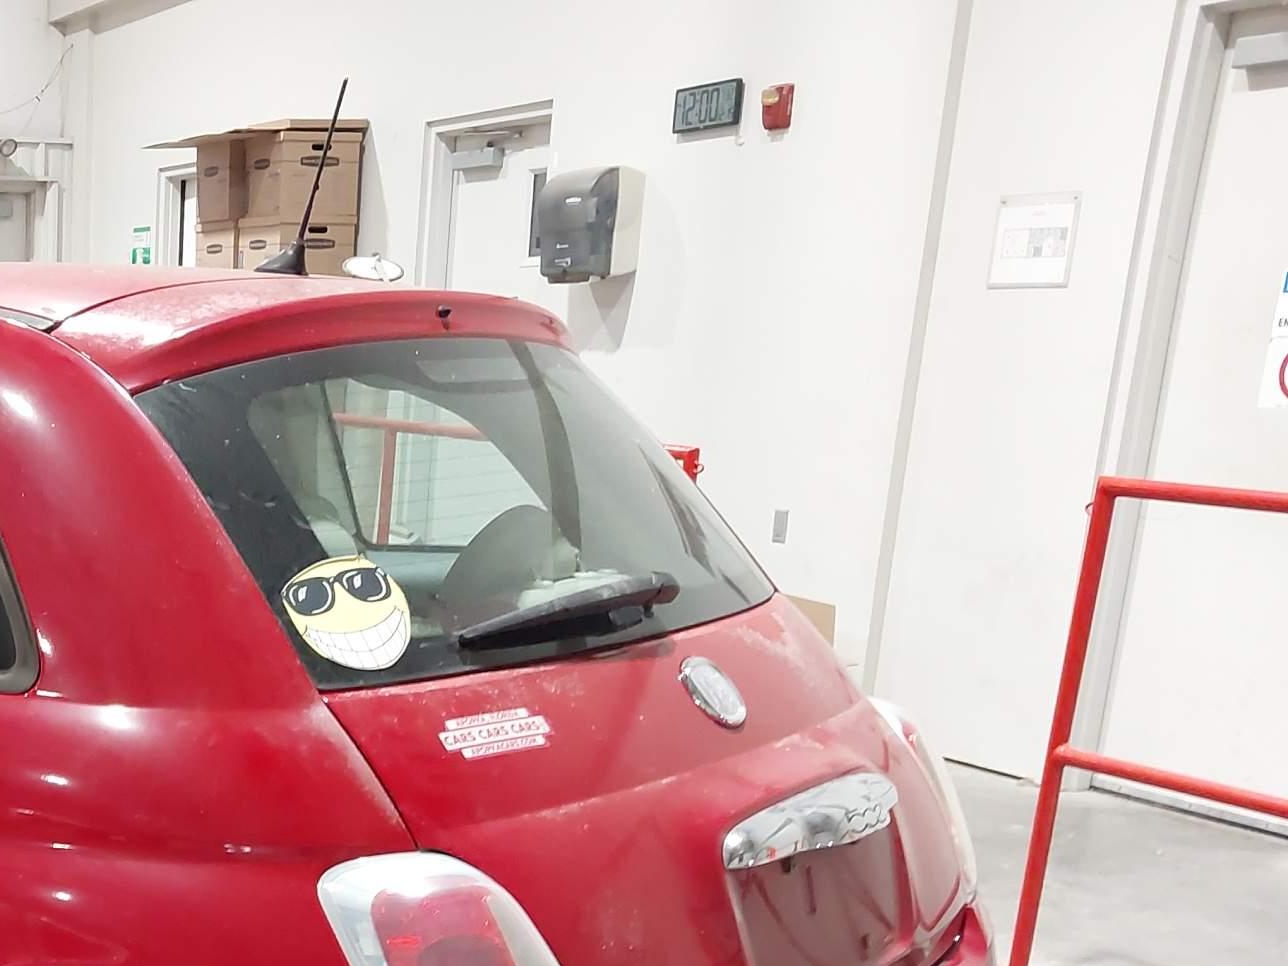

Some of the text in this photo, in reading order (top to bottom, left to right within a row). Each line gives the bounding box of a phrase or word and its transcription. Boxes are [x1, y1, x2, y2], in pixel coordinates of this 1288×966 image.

[444, 719, 540, 747] CARS CARS CARS
